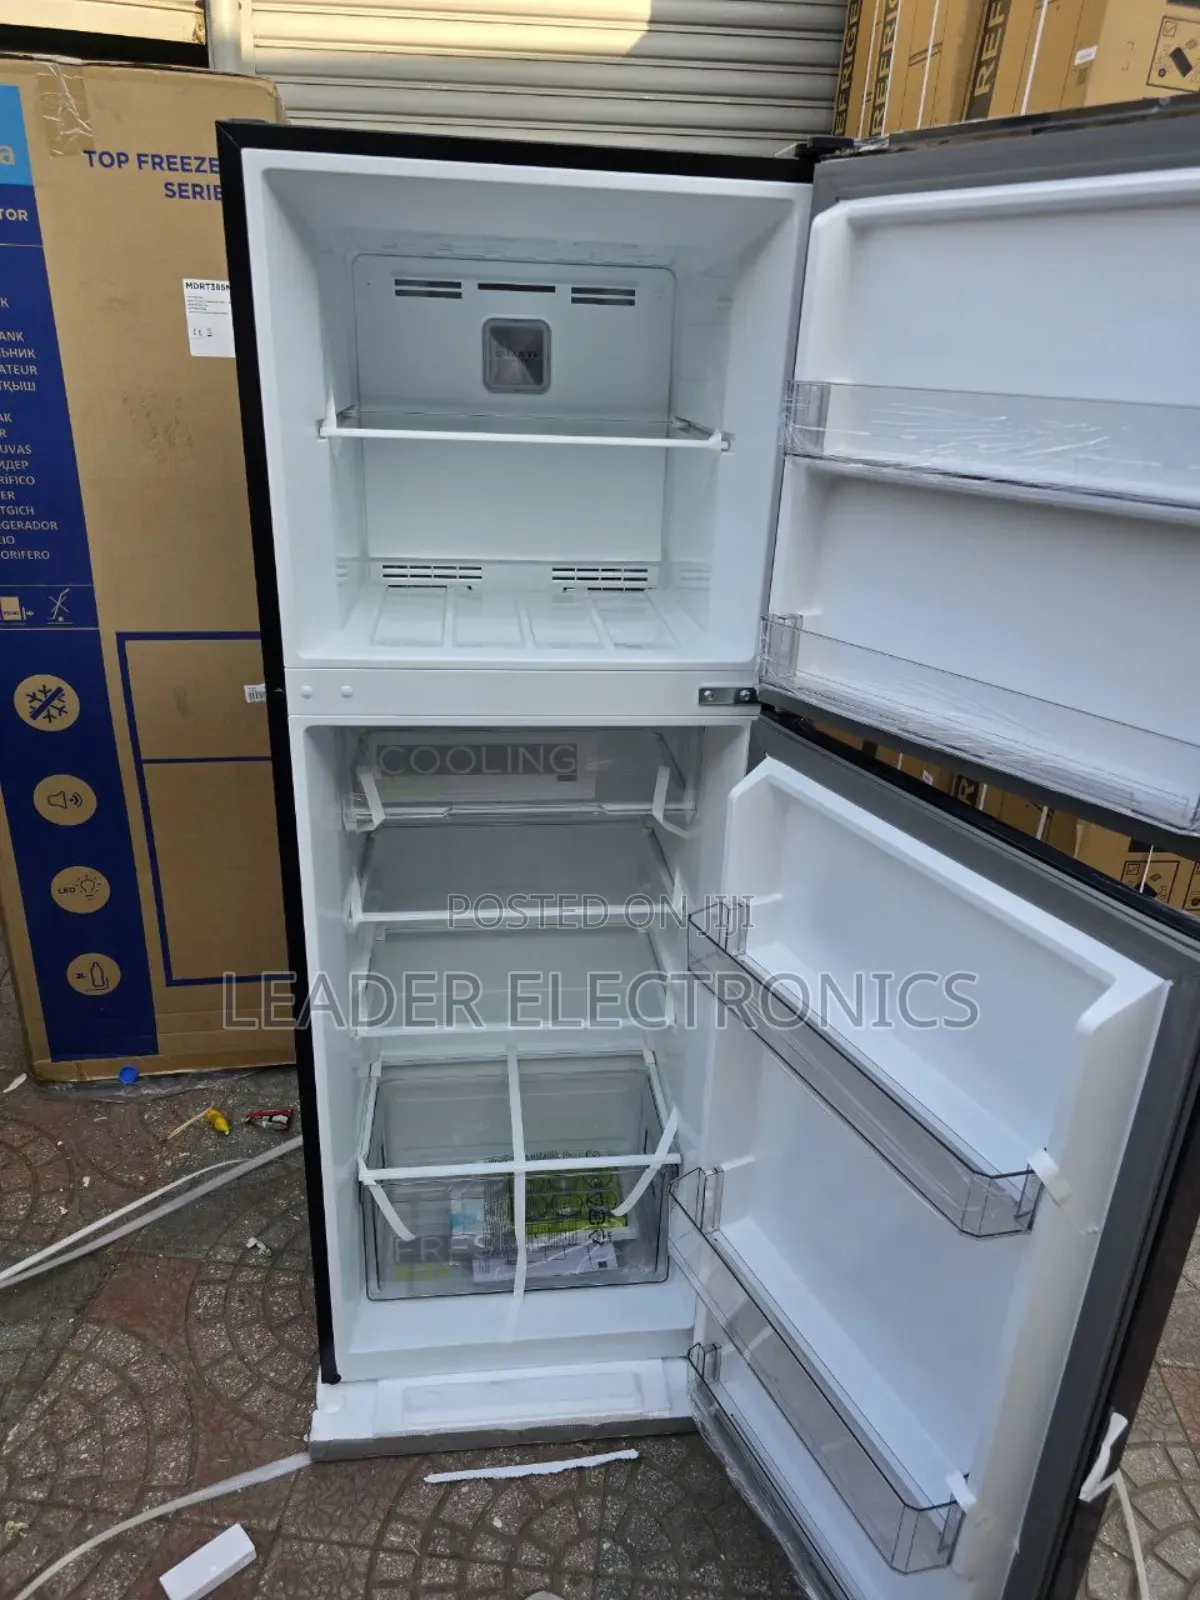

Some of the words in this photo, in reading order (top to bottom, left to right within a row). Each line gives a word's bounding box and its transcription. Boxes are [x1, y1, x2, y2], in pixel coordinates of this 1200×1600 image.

[83, 149, 130, 169] TOP
[136, 152, 220, 175] FREEZE
[163, 181, 223, 201] SERIE
[0, 208, 29, 221] TOR
[0, 348, 36, 358] ЬНИК
[0, 521, 59, 531] GERADOR
[378, 745, 577, 775] COOLING
